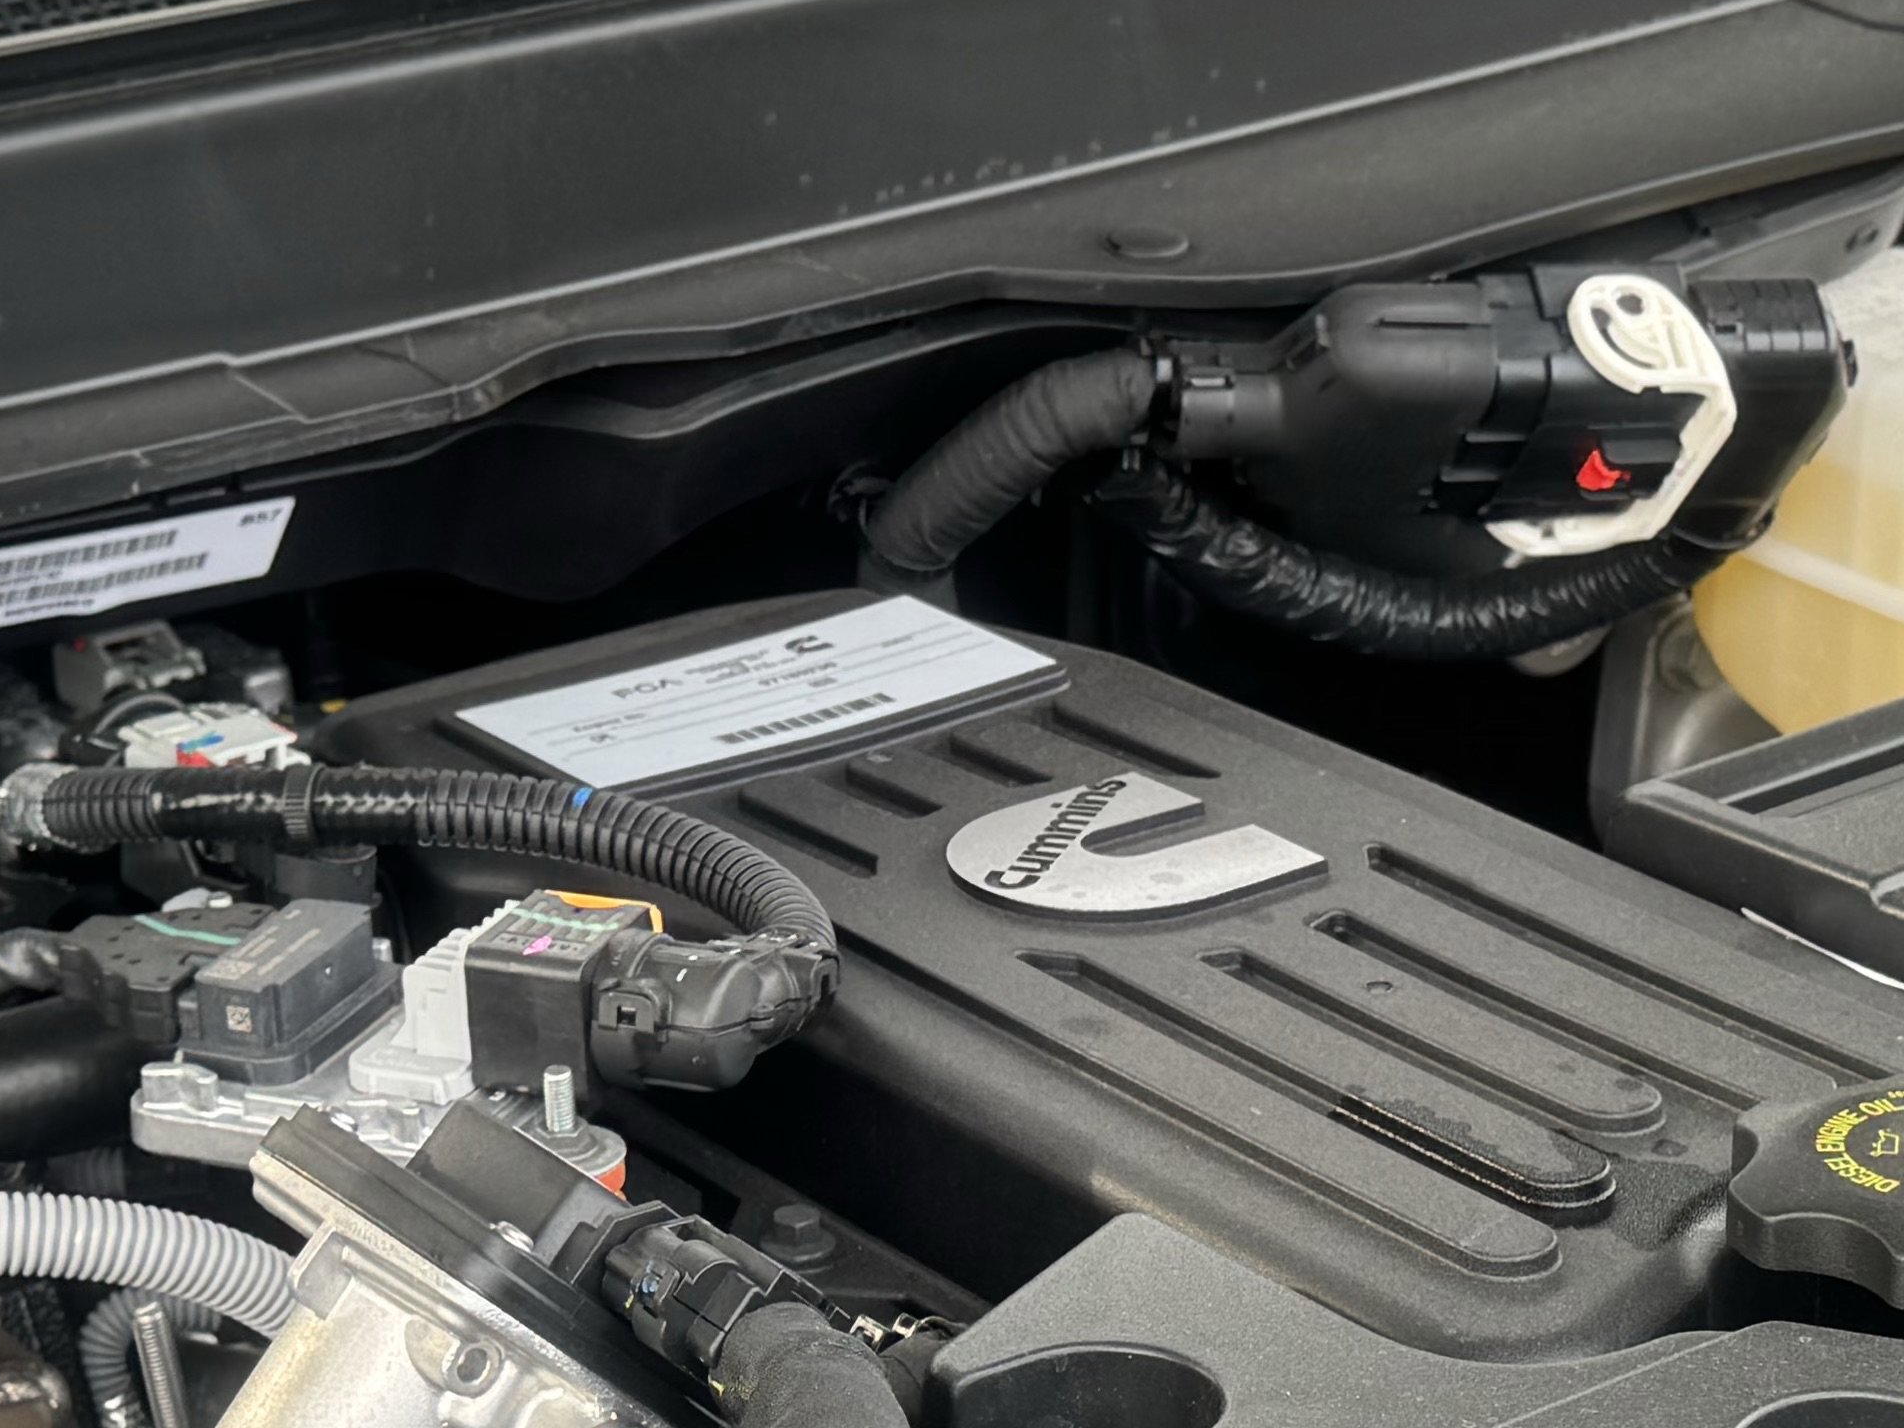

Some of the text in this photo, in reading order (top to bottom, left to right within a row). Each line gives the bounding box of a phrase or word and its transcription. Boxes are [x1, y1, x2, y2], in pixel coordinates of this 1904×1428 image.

[984, 779, 1127, 890] Cummins
[1815, 1108, 1869, 1153] ENGINE
[1823, 1152, 1901, 1194] DIESEL
